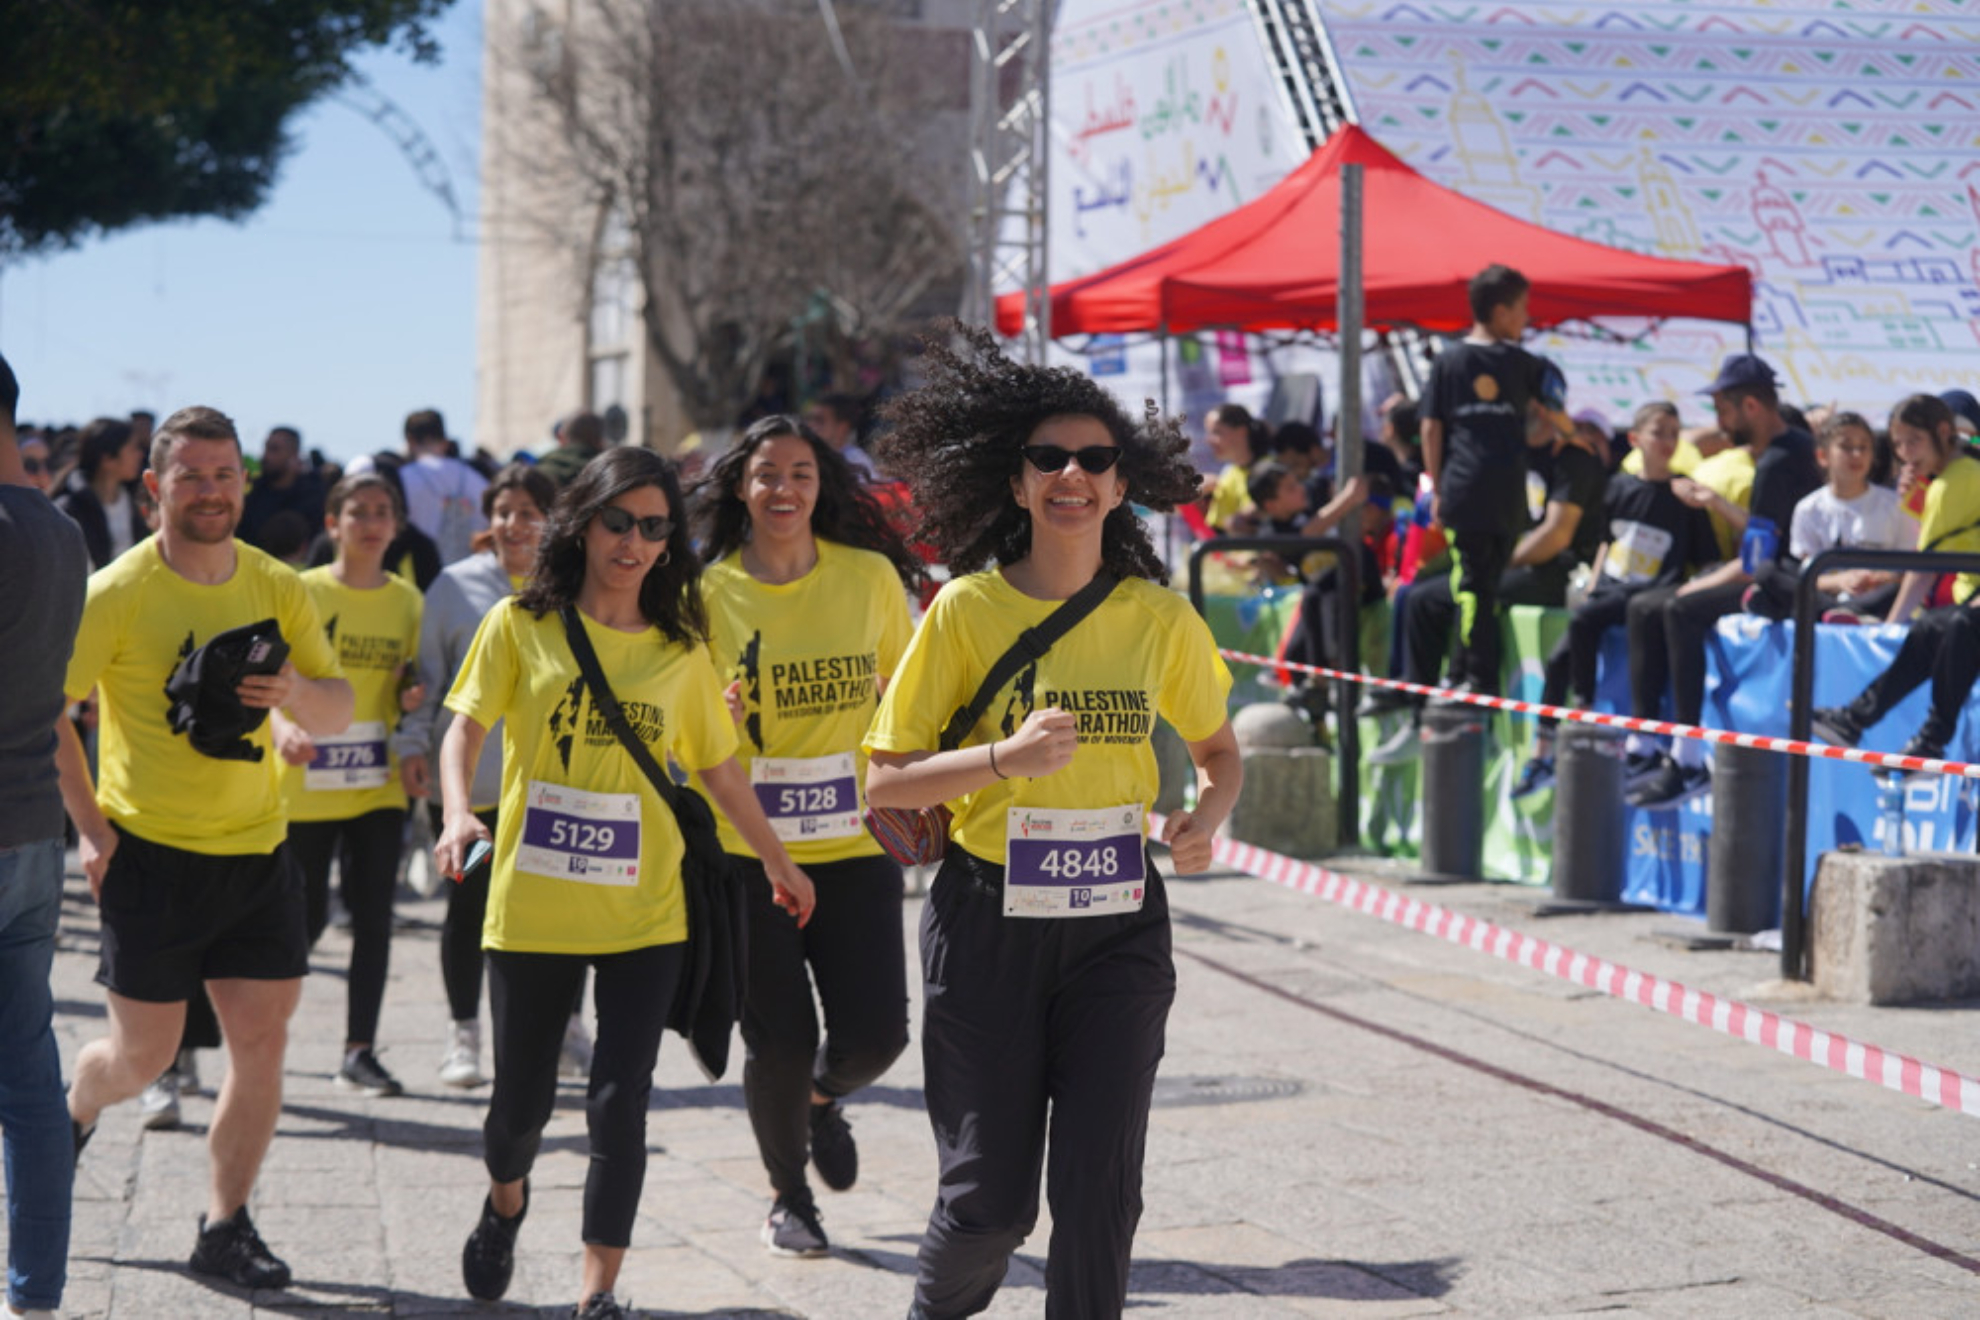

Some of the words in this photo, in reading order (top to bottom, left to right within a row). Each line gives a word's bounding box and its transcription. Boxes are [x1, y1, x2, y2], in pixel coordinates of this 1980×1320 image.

[775, 677, 872, 708] MARATHO
[1045, 690, 1149, 711] PALESTINE
[588, 699, 665, 728] PESTINE
[1074, 712, 1151, 735] RATHON
[585, 719, 664, 742] MAHON
[326, 746, 375, 767] 3776
[779, 786, 837, 813] 5128
[549, 819, 615, 852] 5129
[1039, 846, 1119, 878] 4848
[1073, 890, 1090, 901] 10
